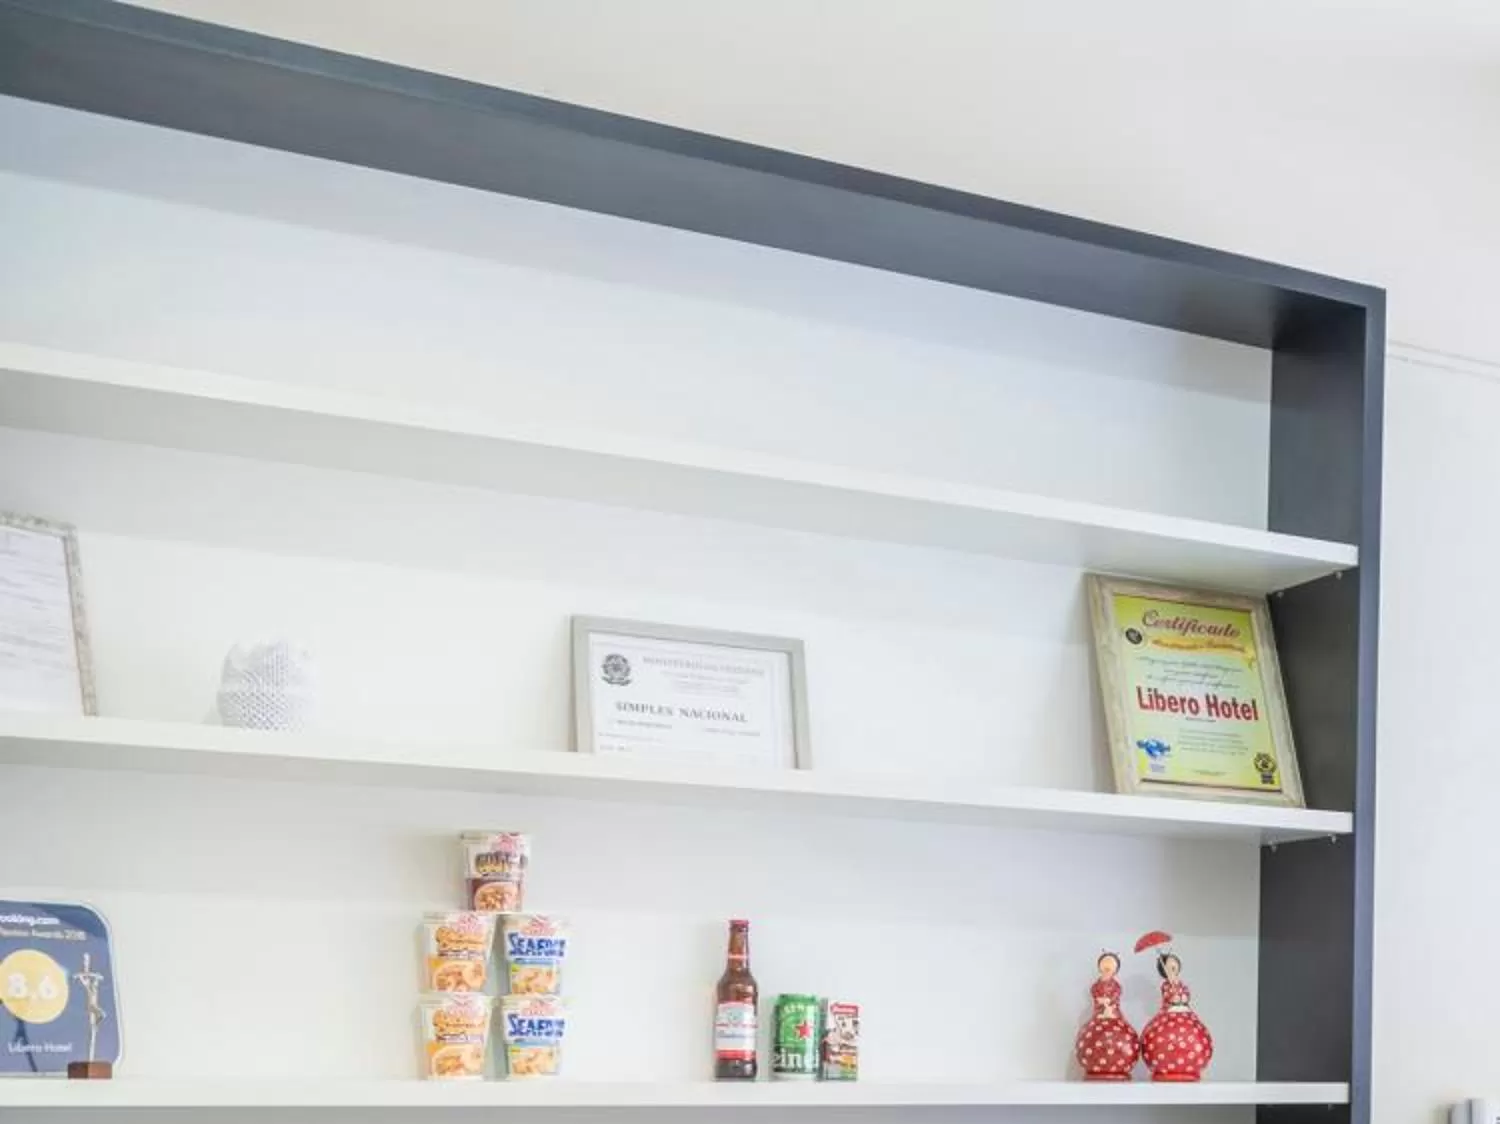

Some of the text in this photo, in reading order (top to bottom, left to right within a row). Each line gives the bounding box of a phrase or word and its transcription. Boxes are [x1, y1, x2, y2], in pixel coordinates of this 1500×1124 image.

[1142, 610, 1241, 638] Certificado
[615, 701, 748, 723] SIMPLES NACIONAL
[1136, 686, 1259, 721] Libero Hotel
